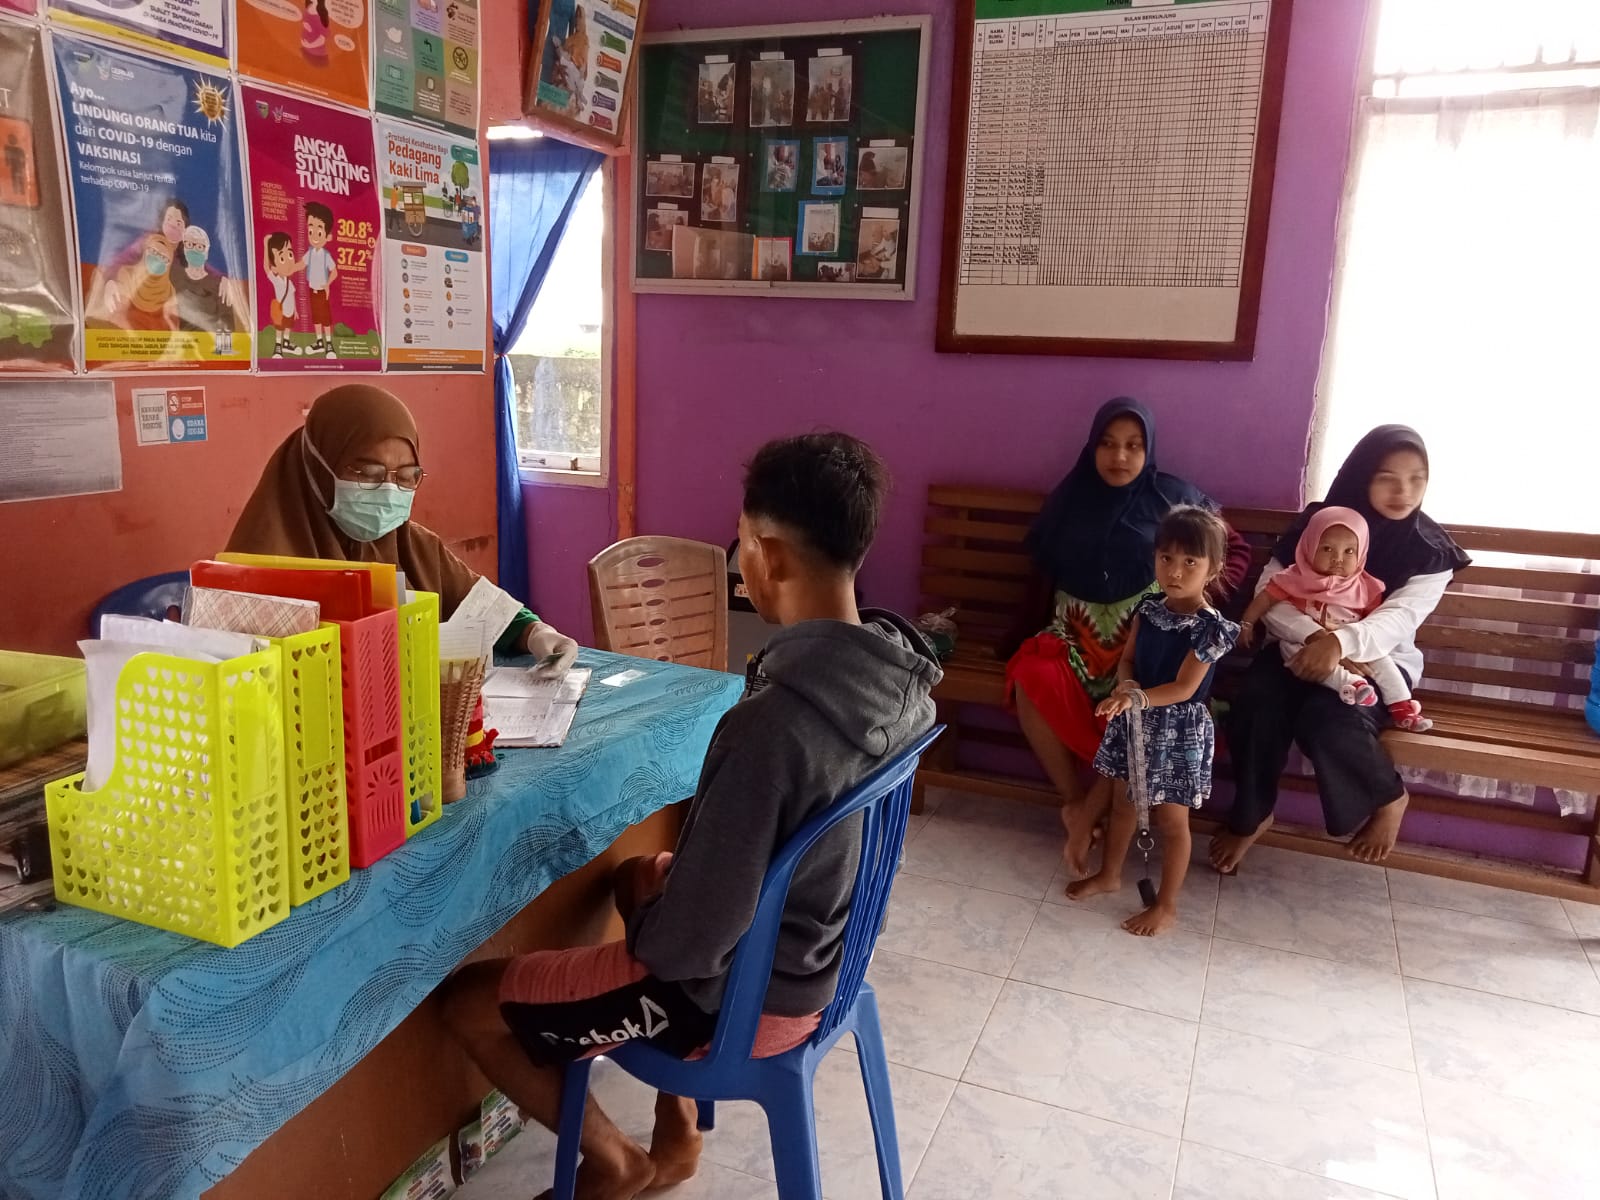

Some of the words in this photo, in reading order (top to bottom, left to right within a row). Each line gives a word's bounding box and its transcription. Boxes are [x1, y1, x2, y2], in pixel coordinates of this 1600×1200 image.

[72, 102, 133, 126] LINDUNGI
[135, 115, 176, 135] ORANG
[177, 124, 199, 139] TUA
[200, 128, 217, 143] kita
[74, 123, 96, 138] dari
[97, 127, 154, 148] COVID-19
[156, 138, 193, 156] dengan
[77, 142, 141, 165] VAKSINASI
[293, 134, 348, 162] ANGKA
[295, 151, 370, 184] STUNTING
[388, 140, 442, 170] Pedagang
[79, 161, 116, 176] Kelompok
[117, 169, 132, 178] usia
[80, 175, 114, 189] terhadap
[295, 169, 350, 196] TURUN
[389, 159, 412, 179] Kaki
[415, 166, 440, 185] Lima
[540, 1017, 646, 1046] ebok
